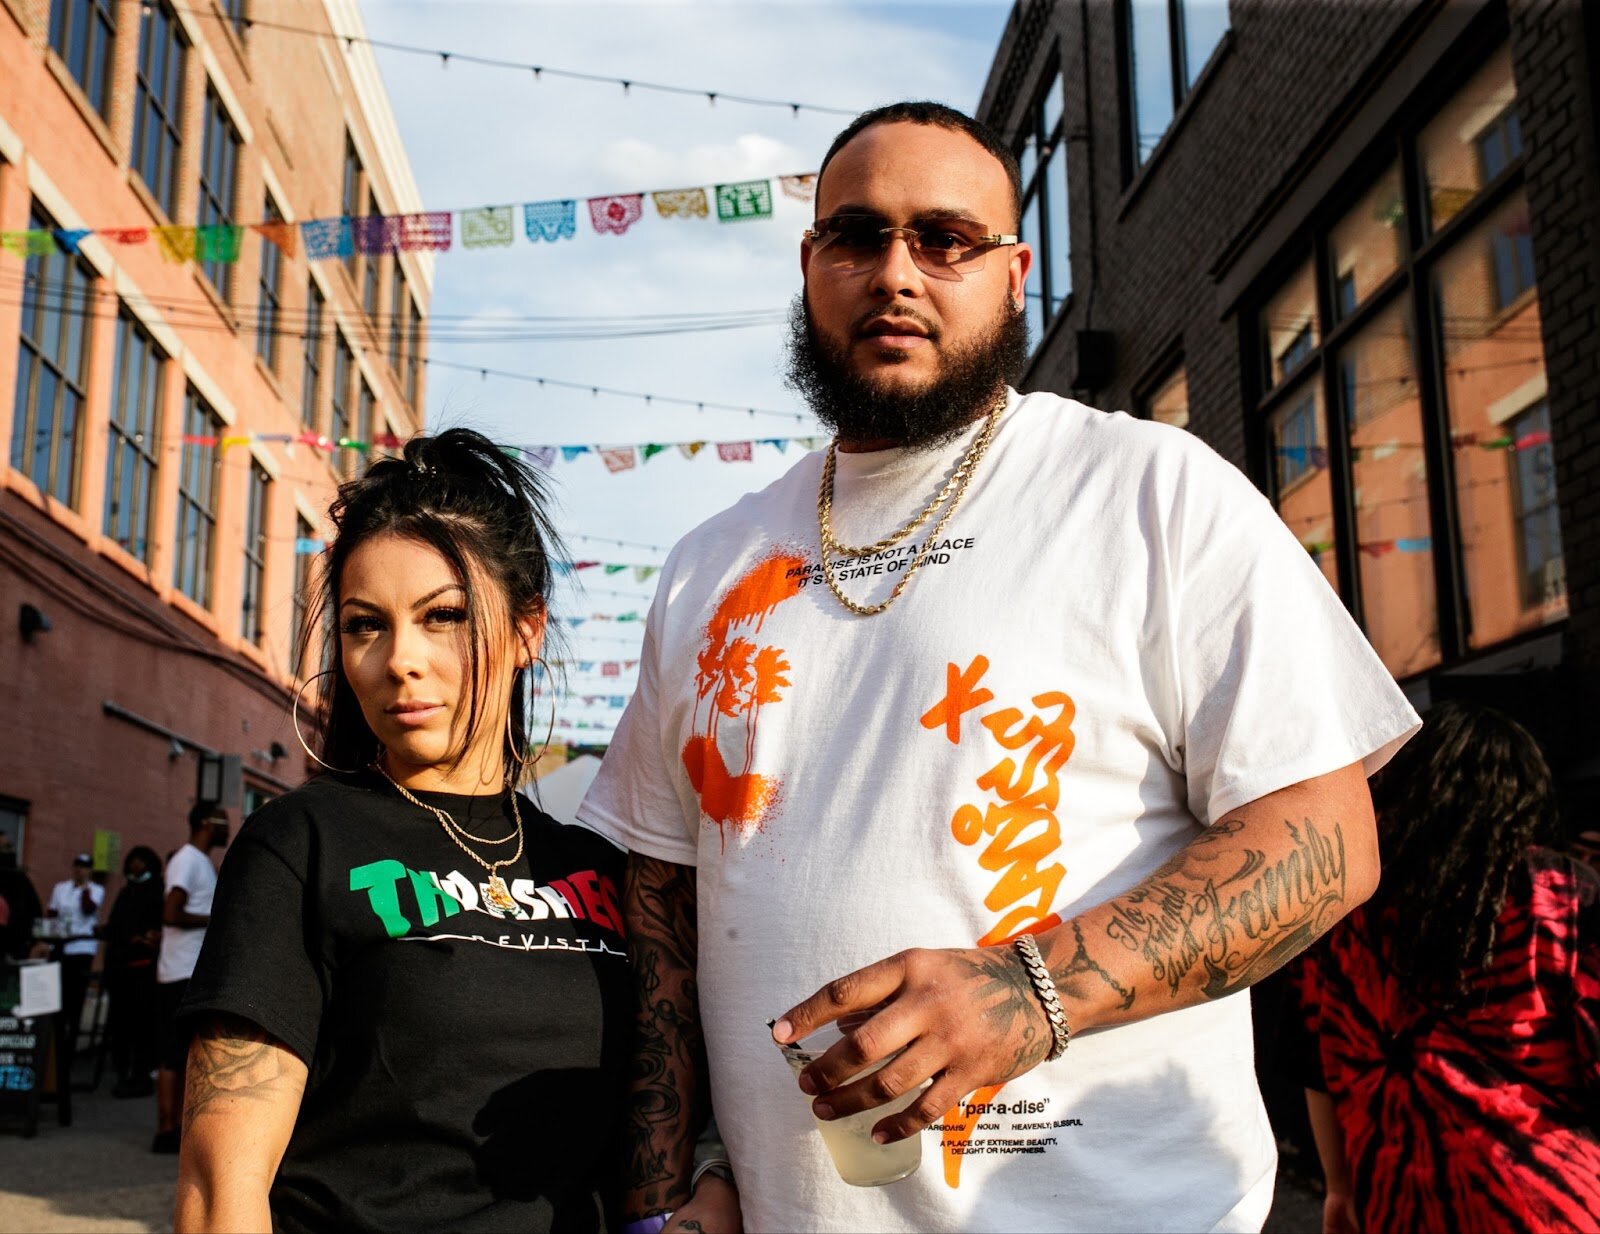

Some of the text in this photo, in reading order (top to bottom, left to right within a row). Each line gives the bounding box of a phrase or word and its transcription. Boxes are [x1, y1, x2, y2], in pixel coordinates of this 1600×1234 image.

[857, 554, 871, 565] IS
[874, 547, 905, 562] NOT
[906, 544, 918, 555] A
[798, 574, 824, 588] IT'S
[838, 563, 884, 581] STATE
[887, 559, 908, 572] OF
[1191, 816, 1346, 963] Family
[977, 1123, 1000, 1131] NOUN
[1053, 1118, 1083, 1128] BLISSFUL
[946, 1139, 973, 1147] PLACE
[1026, 1137, 1058, 1146] BEAUTY,
[951, 1147, 985, 1155] DELIGHT
